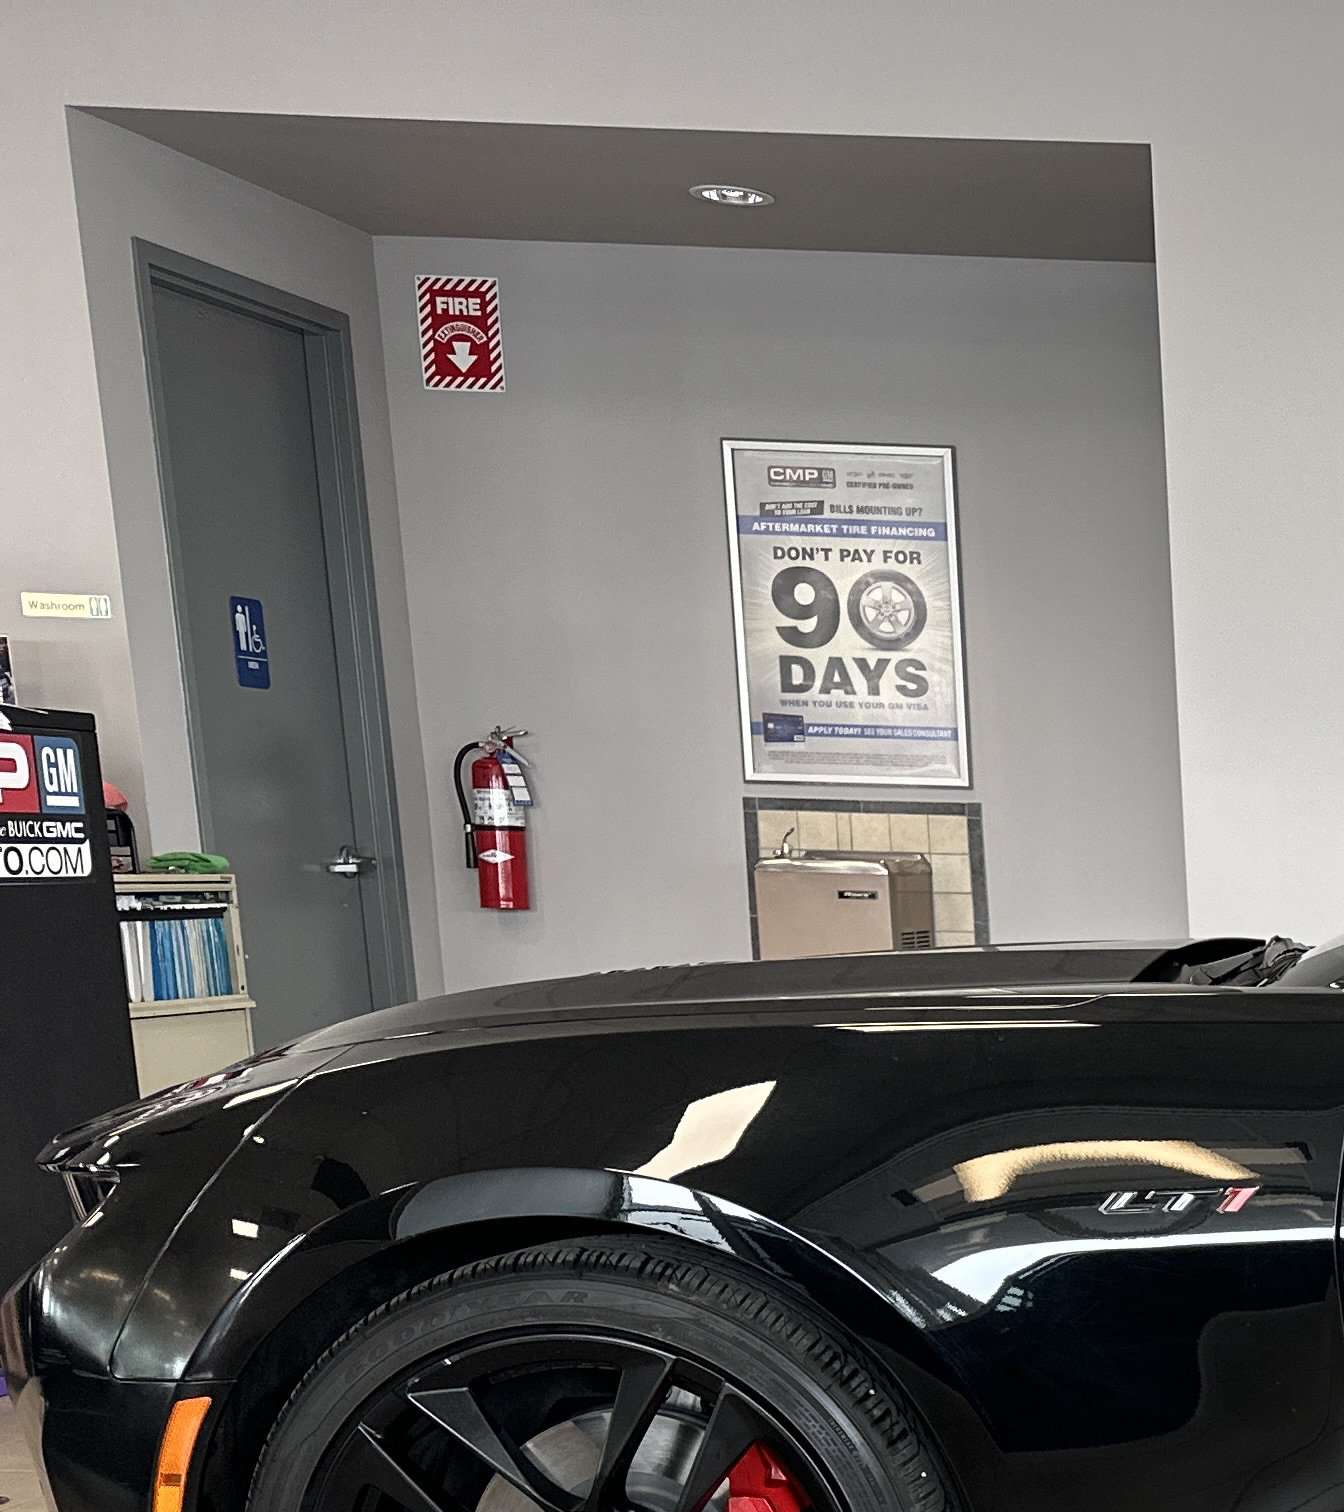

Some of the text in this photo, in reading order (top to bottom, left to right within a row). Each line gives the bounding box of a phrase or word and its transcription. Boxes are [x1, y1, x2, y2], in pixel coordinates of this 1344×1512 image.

[435, 296, 482, 316] FIRE
[770, 467, 818, 481] CMP
[829, 503, 854, 514] BILLS
[856, 505, 903, 516] MOUNTING
[905, 507, 923, 516] UP?
[752, 521, 936, 537] AFTERMARKET TIRE FINANCING
[772, 546, 923, 565] DON'T PAY FOR
[28, 599, 86, 613] Washroom
[778, 655, 930, 699] DAYS
[813, 700, 833, 708] YOU
[835, 701, 855, 709] USE
[858, 702, 885, 710] YOUR
[808, 726, 832, 734] APPLY
[41, 746, 79, 793] GM
[7, 820, 42, 838] BUICK
[42, 821, 85, 838] GMC
[0, 846, 84, 875] O.COM
[1098, 1184, 1262, 1215] LT1
